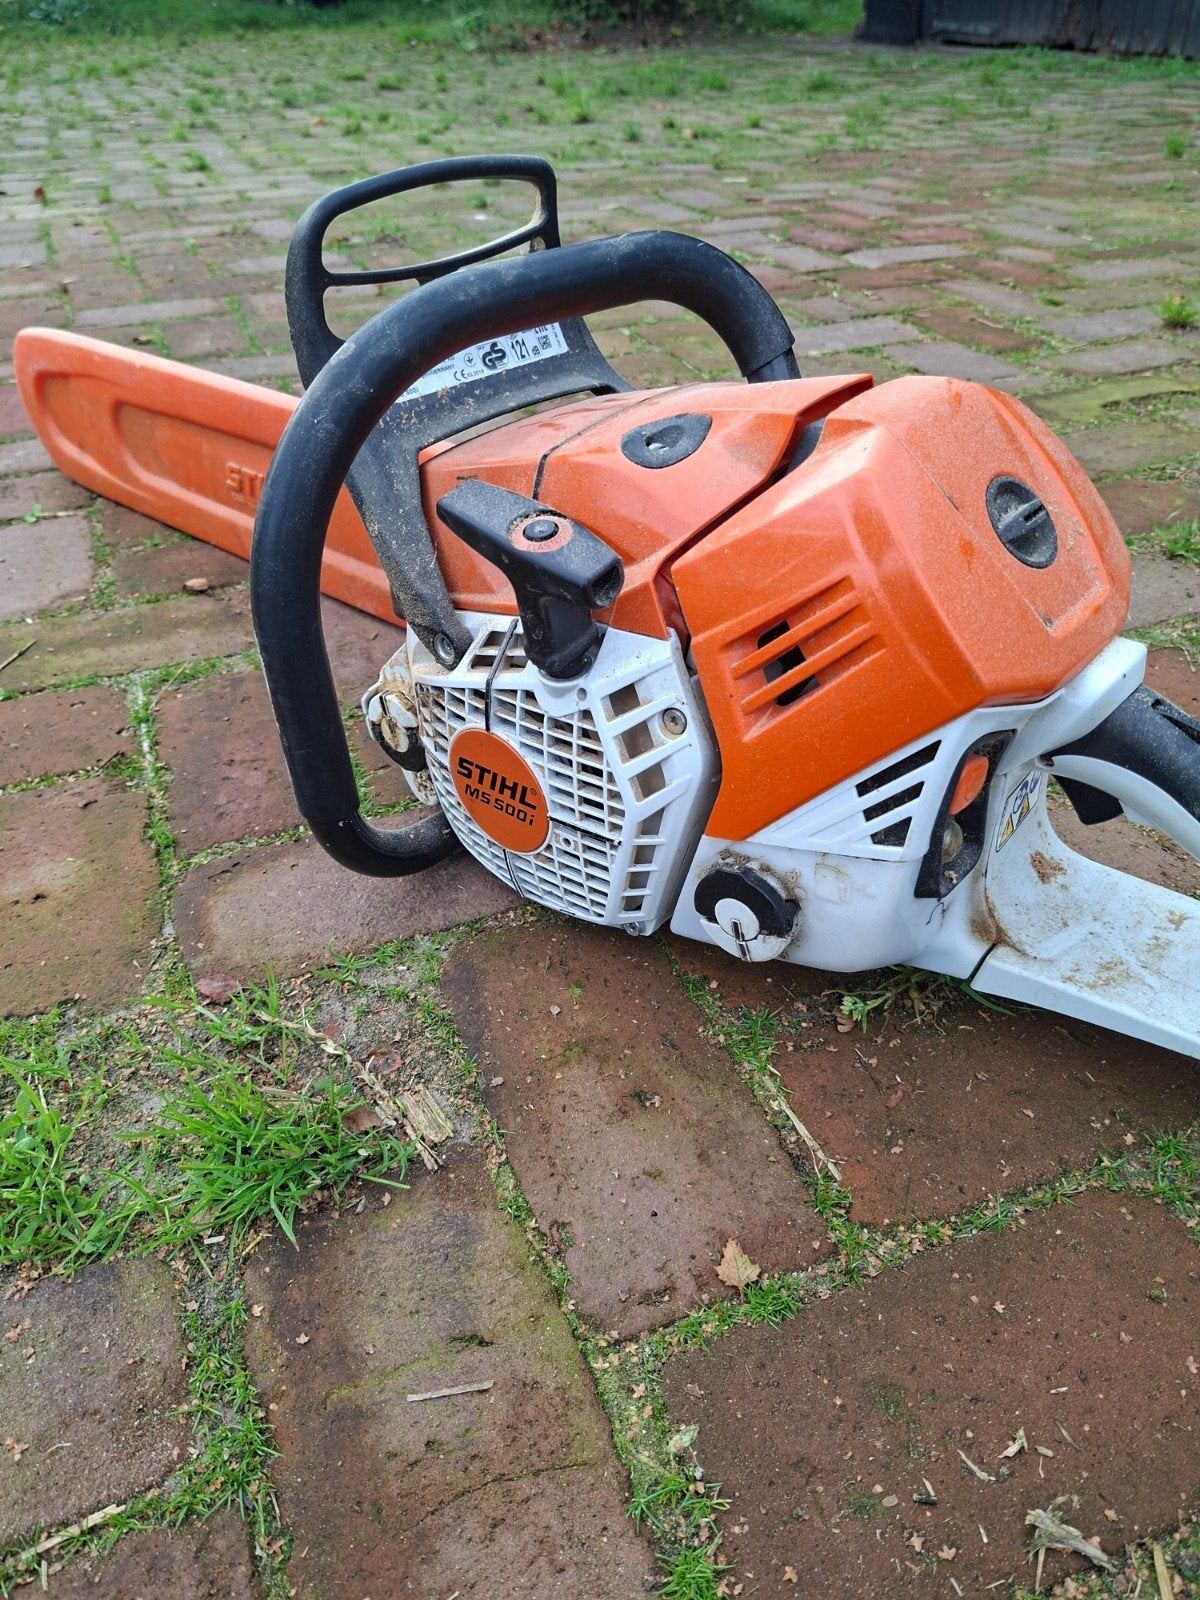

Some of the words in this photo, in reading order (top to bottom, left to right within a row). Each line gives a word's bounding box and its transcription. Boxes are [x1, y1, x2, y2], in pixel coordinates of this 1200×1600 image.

[511, 338, 530, 360] 121
[456, 756, 537, 811] STIHL
[464, 783, 492, 806] MS
[493, 797, 535, 827] 500i
